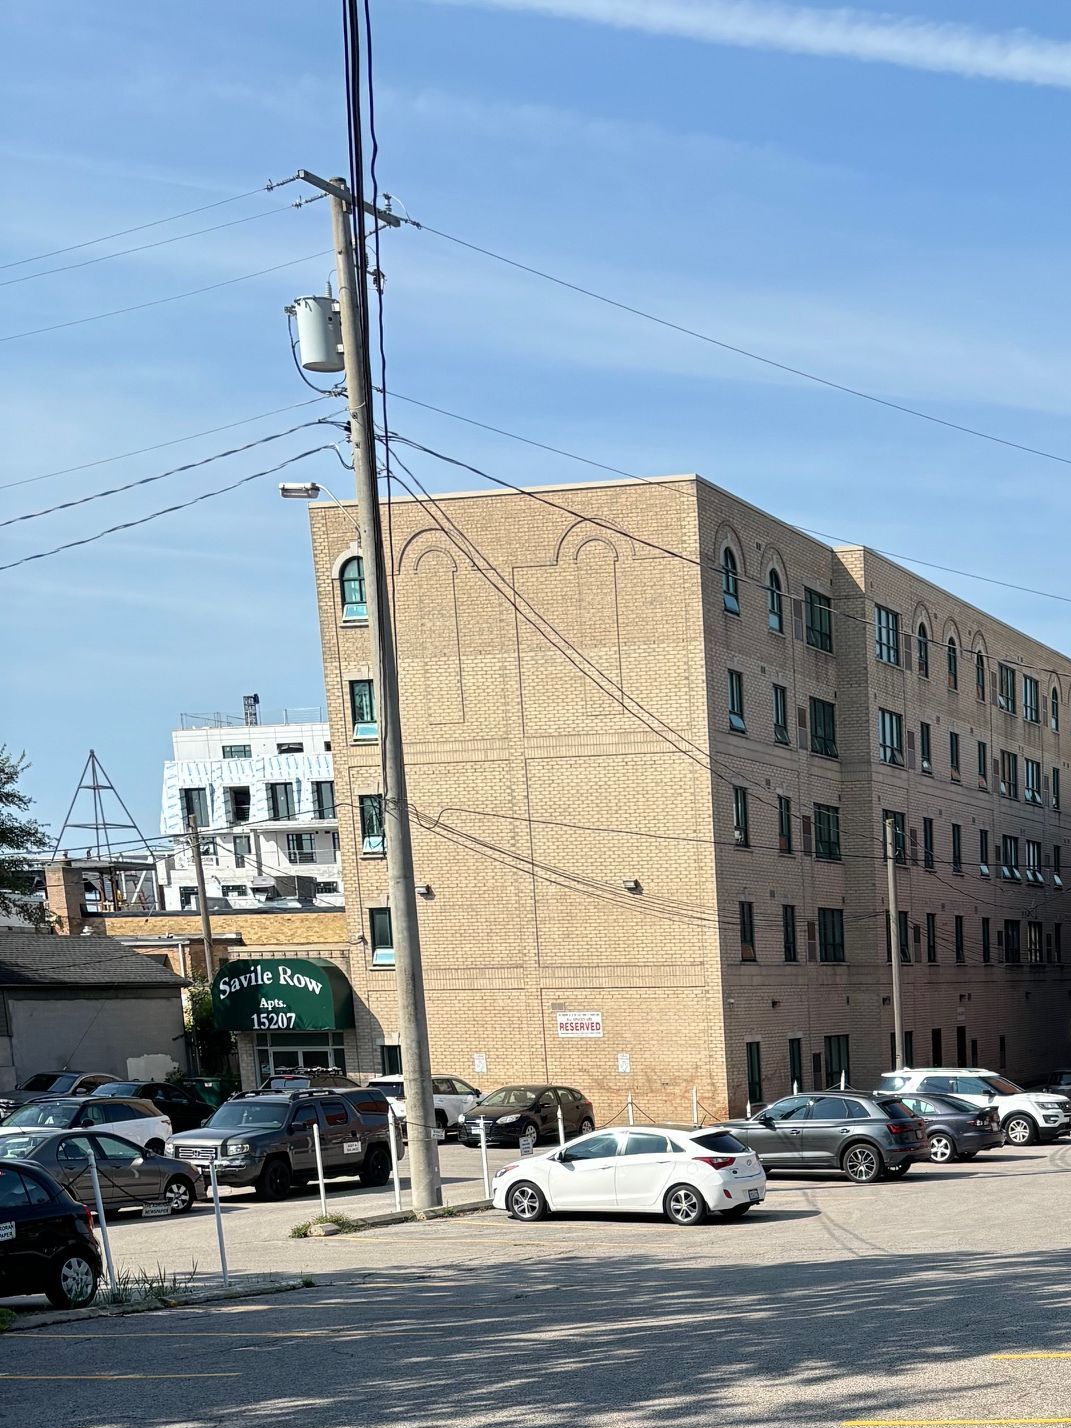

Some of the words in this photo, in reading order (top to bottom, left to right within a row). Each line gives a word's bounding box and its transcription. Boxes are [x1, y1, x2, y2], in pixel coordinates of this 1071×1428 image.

[219, 964, 273, 1000] Savile
[278, 965, 322, 995] Row
[259, 997, 287, 1011] Apts.
[251, 1012, 296, 1030] 15207
[559, 1022, 601, 1031] RESERVED
